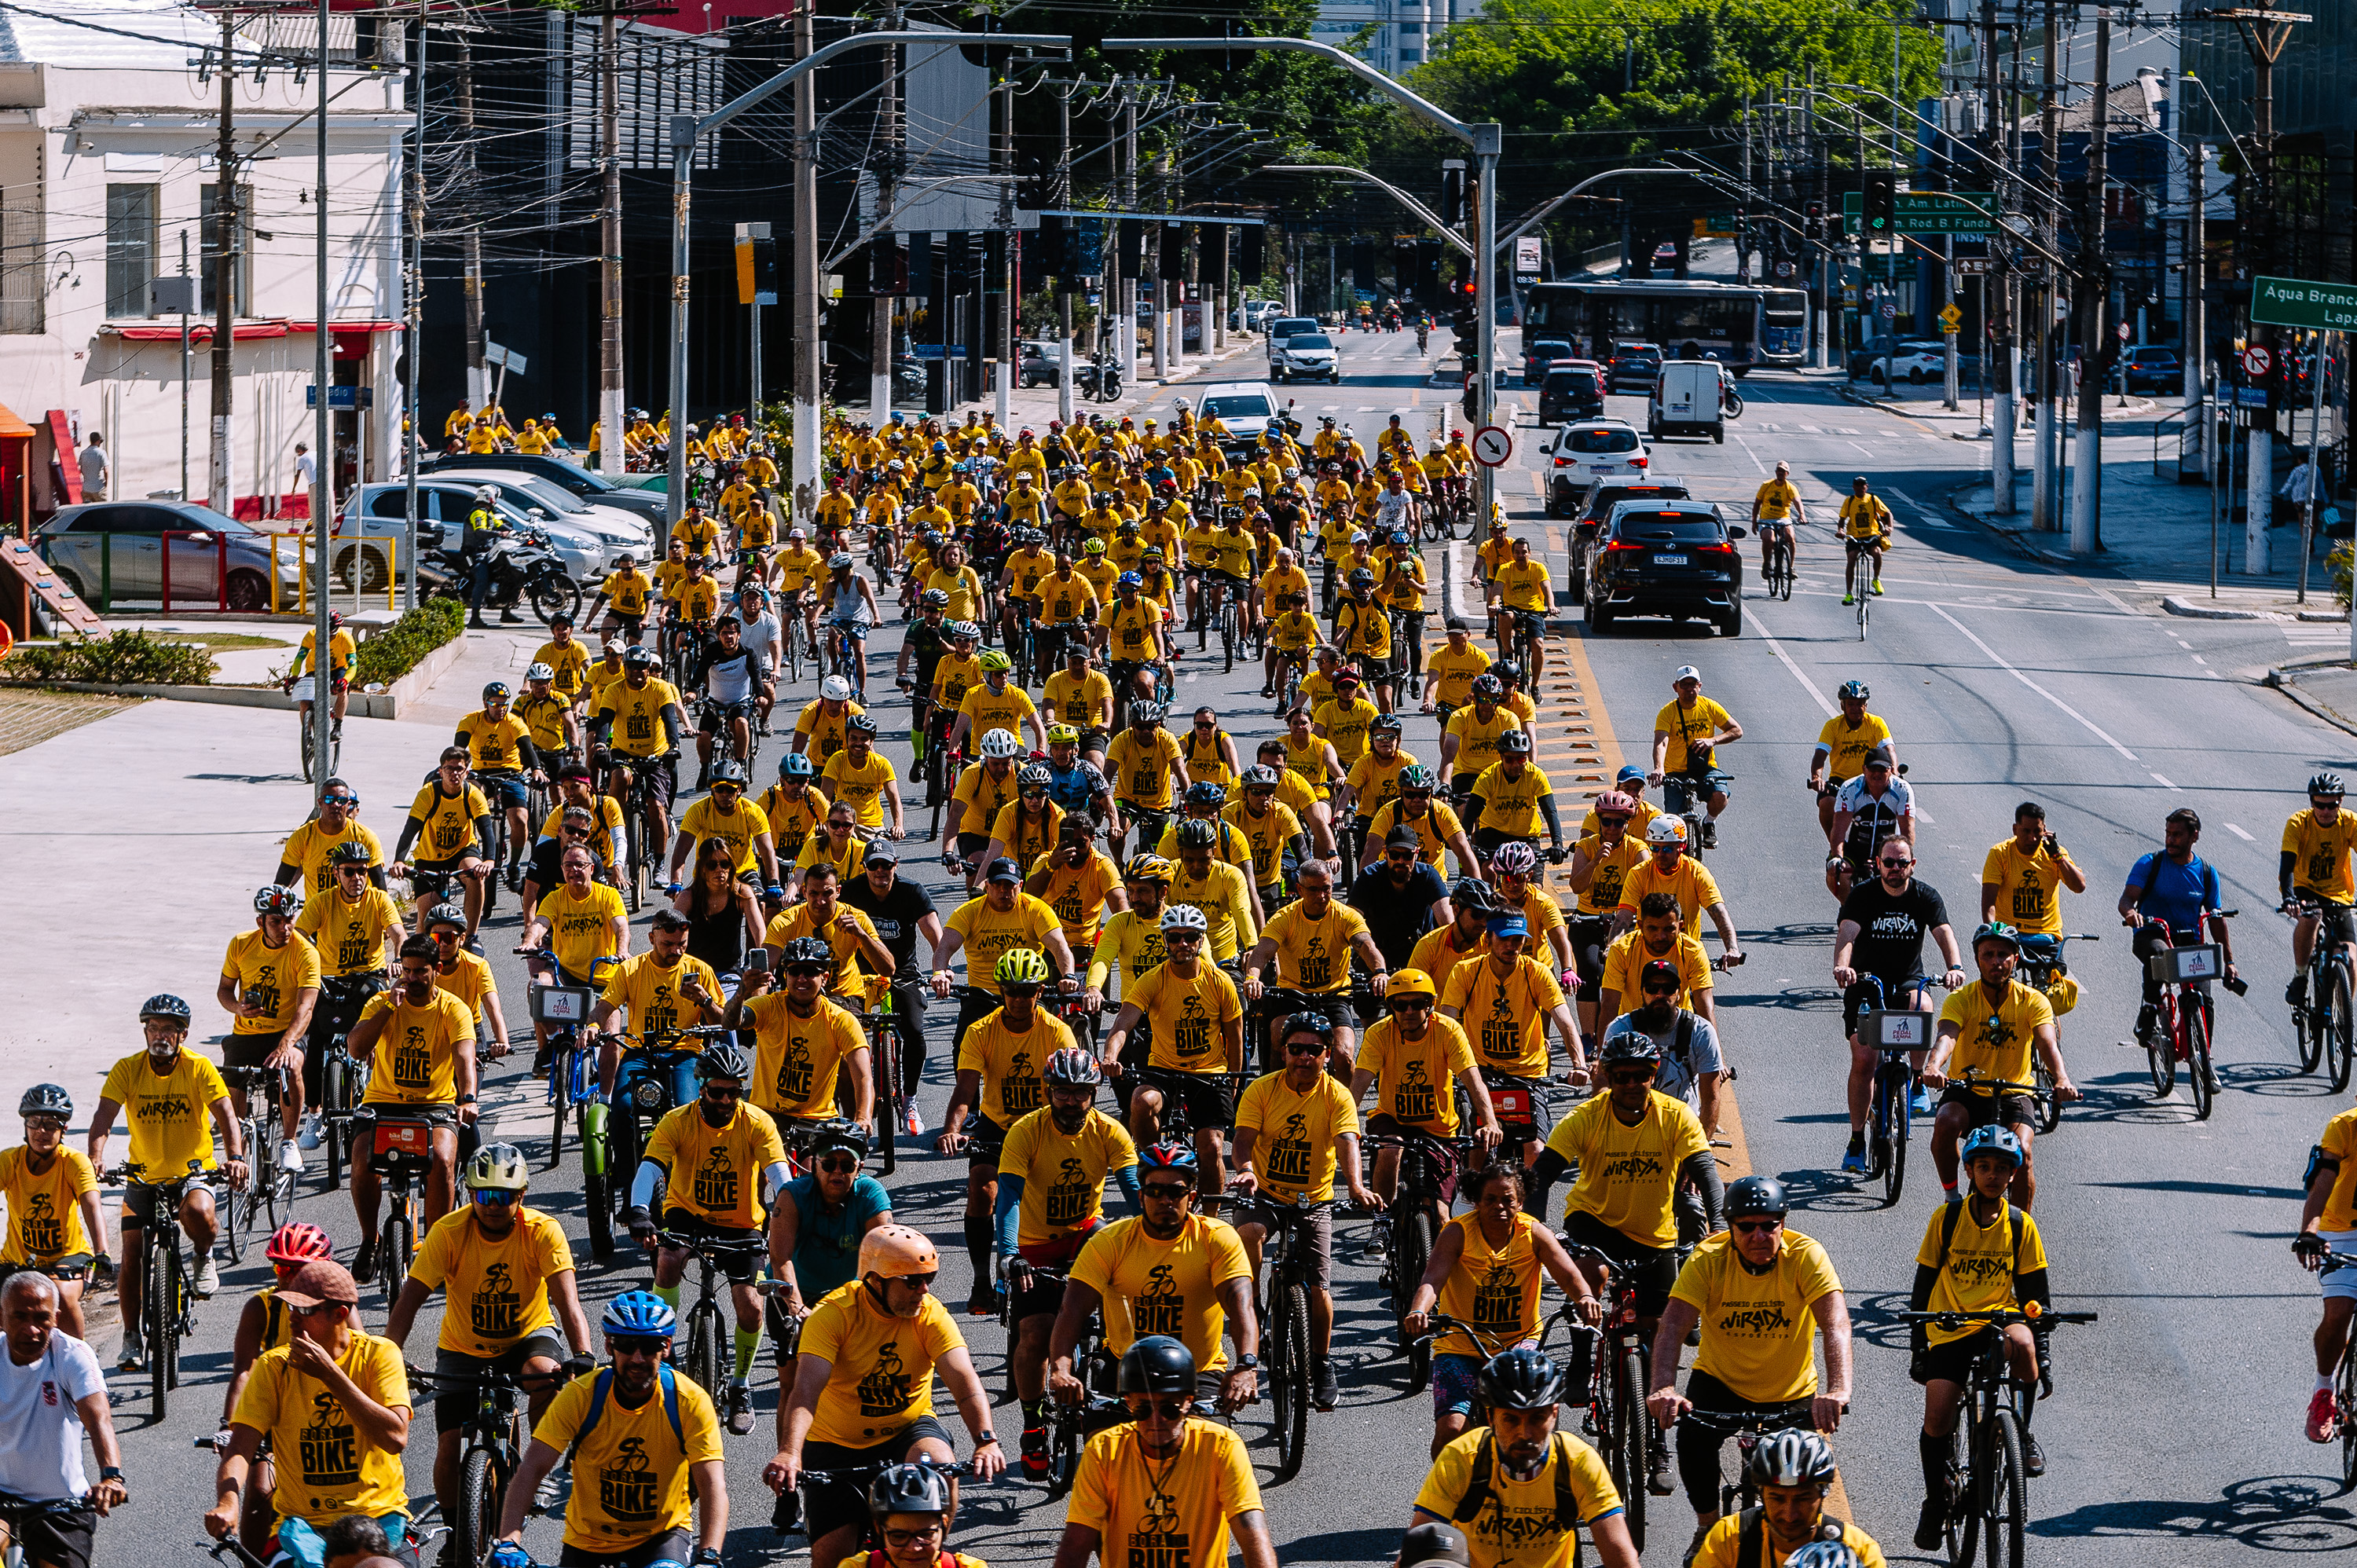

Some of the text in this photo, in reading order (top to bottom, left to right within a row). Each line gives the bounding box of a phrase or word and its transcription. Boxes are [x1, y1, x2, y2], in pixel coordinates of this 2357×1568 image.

[1908, 198, 1931, 208] Am.
[1909, 218, 1934, 228] Rod.
[1939, 218, 1952, 228] B.
[2264, 282, 2357, 306] Água Branc
[555, 672, 574, 685] BIKE
[1066, 705, 1088, 716] BIKE
[626, 720, 651, 735] BIKE
[1132, 777, 1157, 791] BIKE
[436, 830, 462, 846] BIKE
[2013, 894, 2044, 913] BIKE
[338, 945, 370, 965] BIKE
[1299, 964, 1330, 983] BIKE
[1483, 1020, 1506, 1031] BORA
[1175, 1027, 1211, 1050] BIKE
[1482, 1029, 1521, 1052] BIKE
[394, 1048, 420, 1058] BORA
[393, 1057, 431, 1082] BIKE
[777, 1066, 813, 1094] BIKE
[1002, 1085, 1043, 1108] BIKE
[1395, 1084, 1420, 1094] BORA
[1395, 1093, 1435, 1116] BIKE
[1273, 1139, 1296, 1149] BORA
[1267, 1146, 1313, 1176] BIKE
[694, 1169, 723, 1182] BORA
[693, 1178, 738, 1204] BIKE
[1047, 1185, 1076, 1195] BORA
[1046, 1192, 1092, 1218] BIKE
[22, 1225, 63, 1249] BIKE
[471, 1293, 503, 1305] BORA
[1477, 1286, 1505, 1298] BORA
[1135, 1296, 1166, 1306] BORA
[1475, 1295, 1523, 1323] BIKE
[1721, 1299, 1751, 1308] PASSEIO
[471, 1303, 522, 1331] BIKE
[1134, 1304, 1184, 1335] BIKE
[301, 1428, 334, 1442] BORA
[299, 1438, 358, 1474] BIKE
[600, 1469, 636, 1485] BORA
[599, 1480, 658, 1514] BIKE
[1128, 1534, 1168, 1548] BORA
[1128, 1548, 1190, 1568] BIKE
